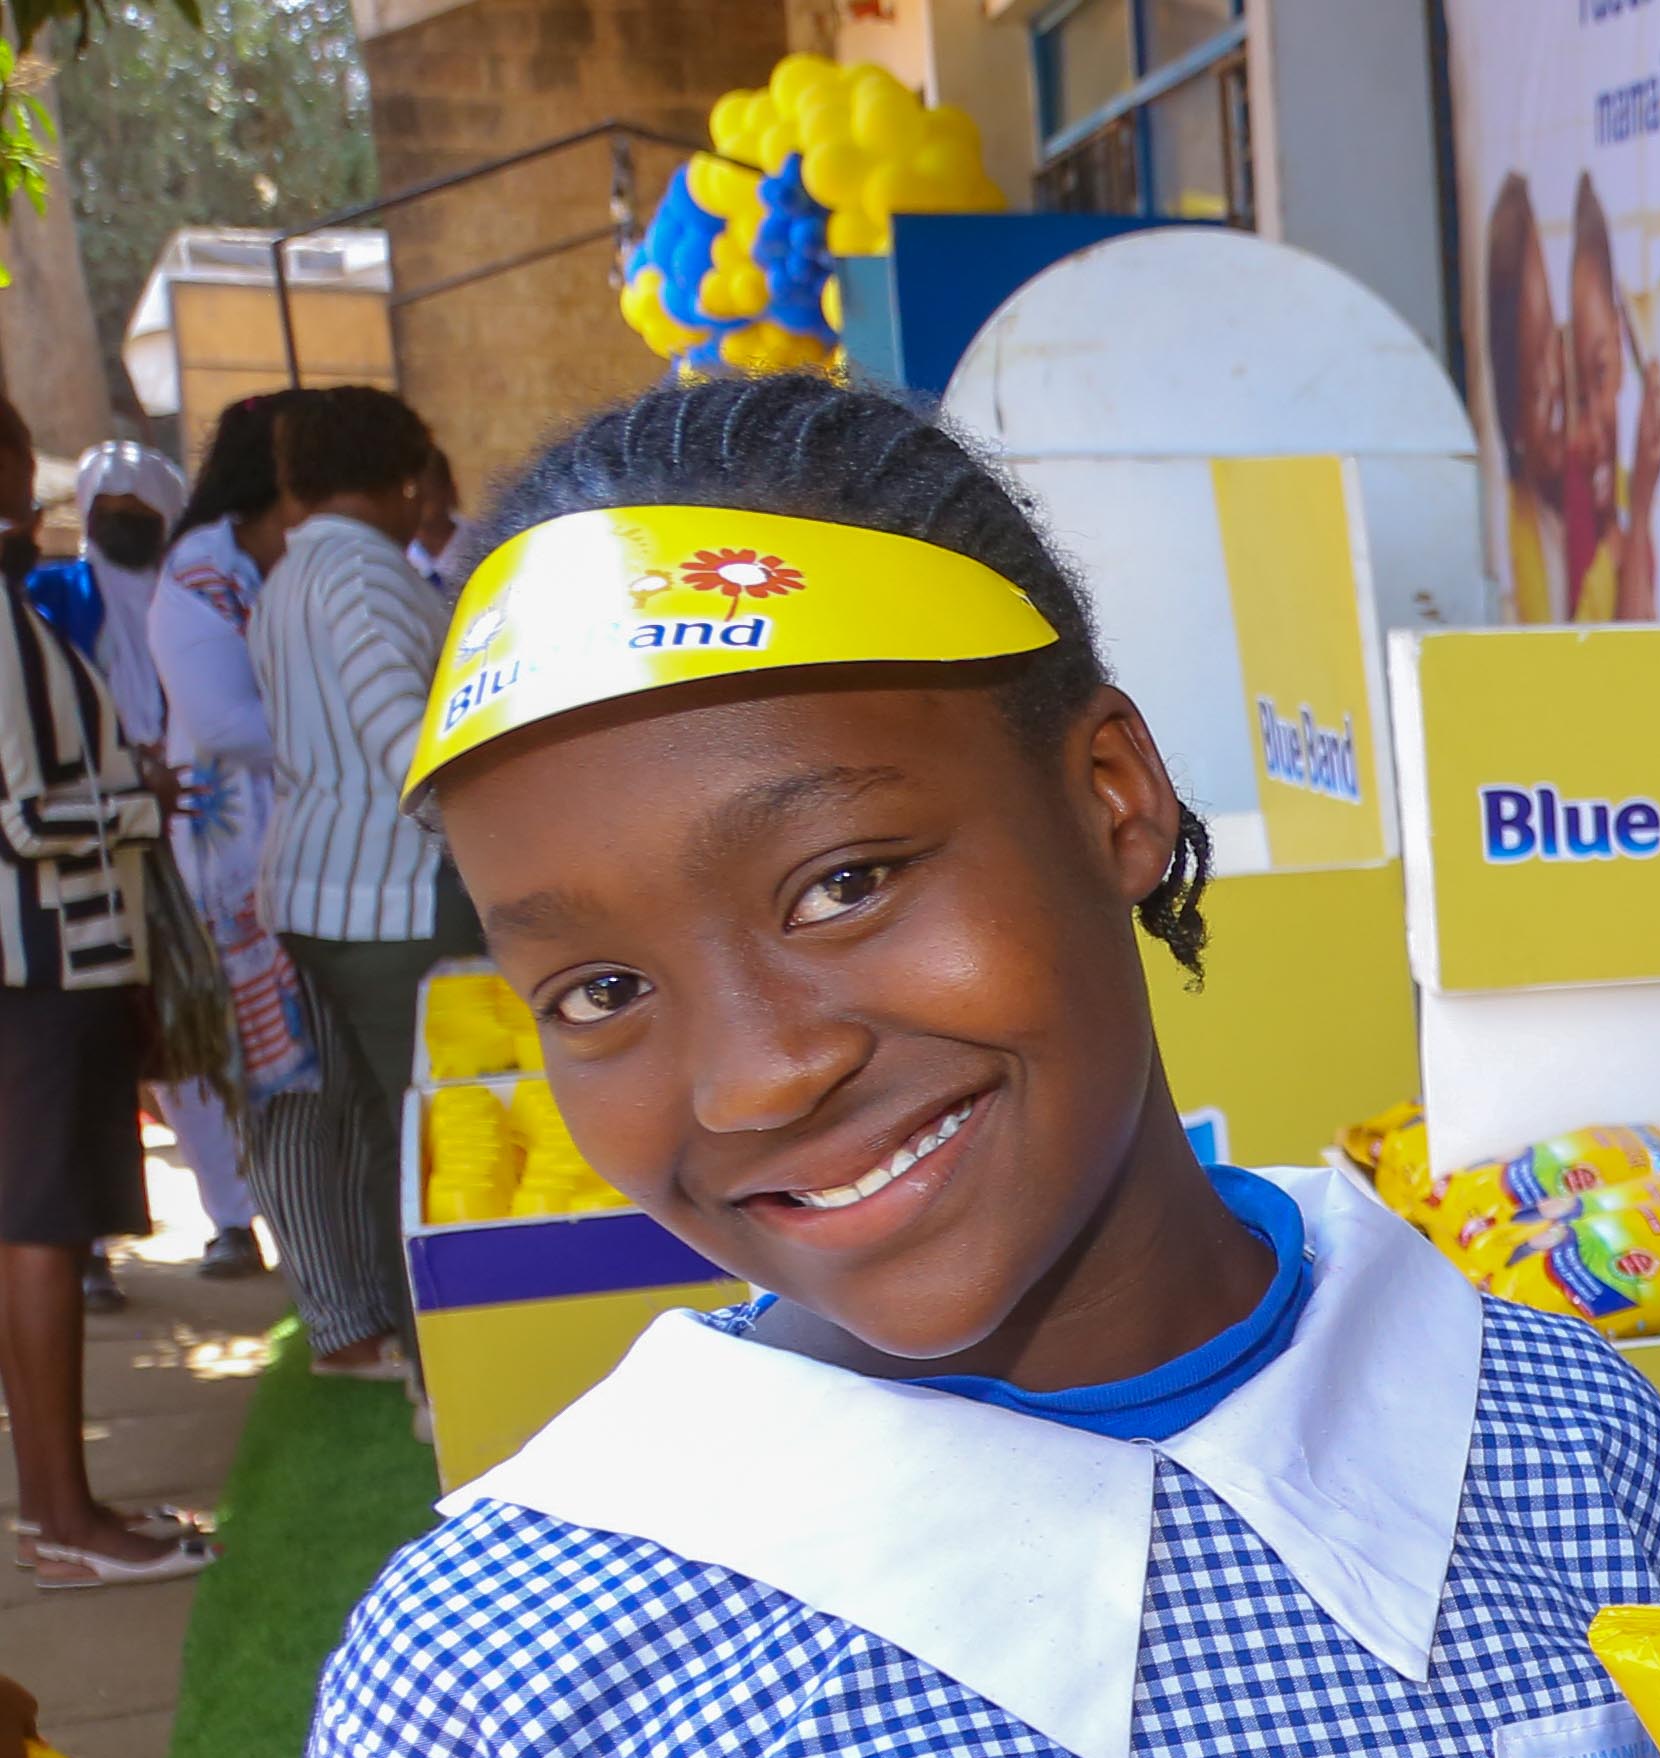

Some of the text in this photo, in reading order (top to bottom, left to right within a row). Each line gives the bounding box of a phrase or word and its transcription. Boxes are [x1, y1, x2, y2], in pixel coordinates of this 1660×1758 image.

[441, 617, 766, 732] Blu and
[1259, 699, 1360, 799] Blue Band
[1483, 787, 1660, 858] Blue
